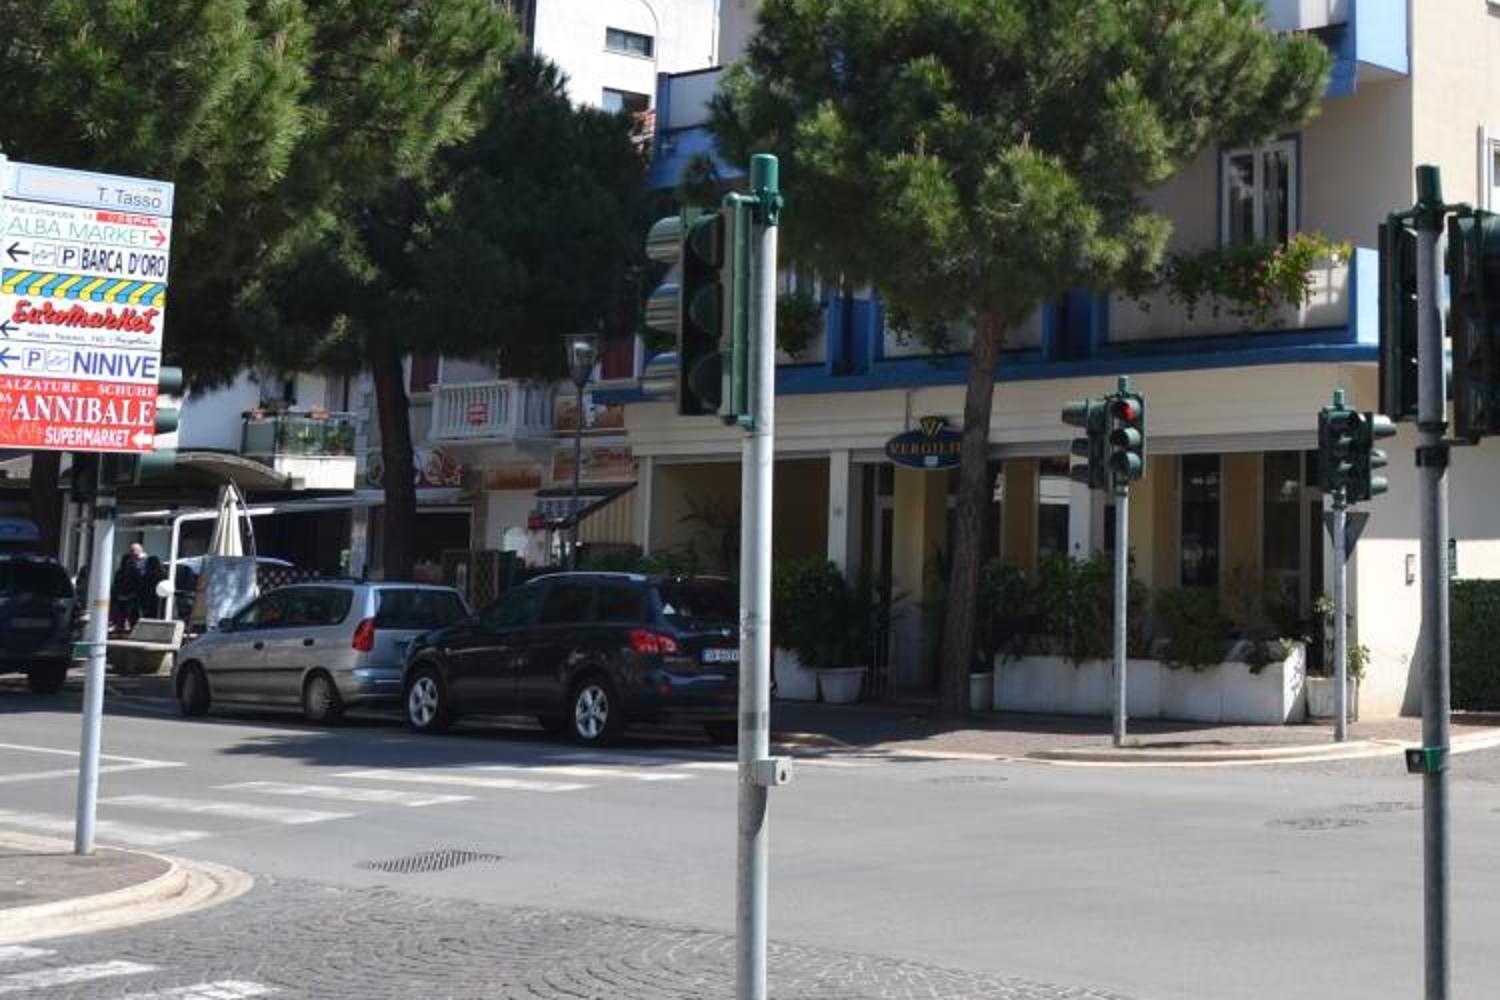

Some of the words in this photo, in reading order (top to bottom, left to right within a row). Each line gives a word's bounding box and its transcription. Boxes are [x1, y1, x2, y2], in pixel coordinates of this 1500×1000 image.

[116, 189, 162, 209] Tasso
[8, 216, 61, 236] ALBA
[69, 222, 150, 245] MARKET
[81, 248, 123, 275] BARCA
[128, 252, 166, 278] D'ORO
[73, 351, 158, 379] NINIVE
[98, 384, 156, 398] SCHUHE
[12, 395, 154, 427] ANNIBALE
[45, 427, 130, 448] SUPERMARKET
